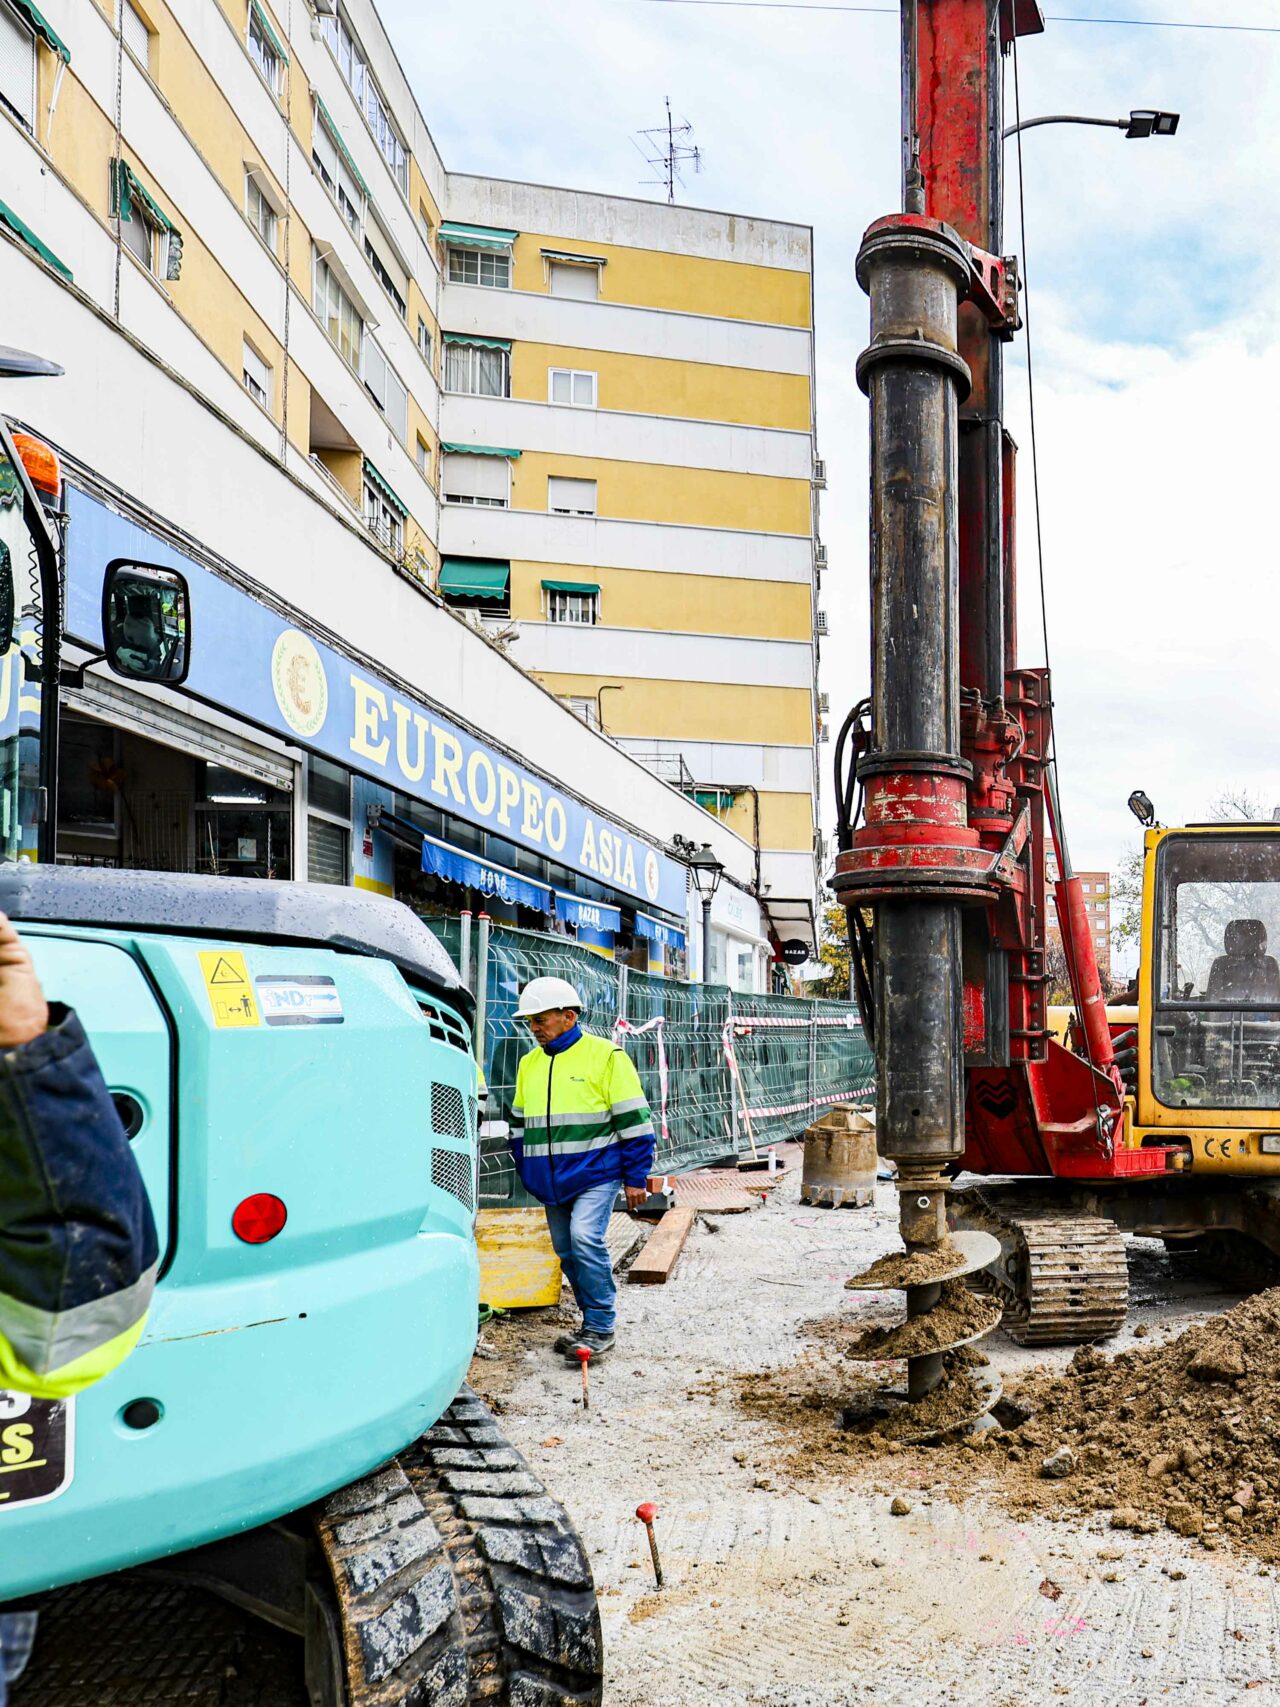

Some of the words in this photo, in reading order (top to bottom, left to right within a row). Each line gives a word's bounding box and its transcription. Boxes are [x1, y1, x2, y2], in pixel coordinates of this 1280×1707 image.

[350, 673, 567, 852] EUROPEO
[580, 819, 638, 890] ASIA
[1204, 1137, 1231, 1158] CE
